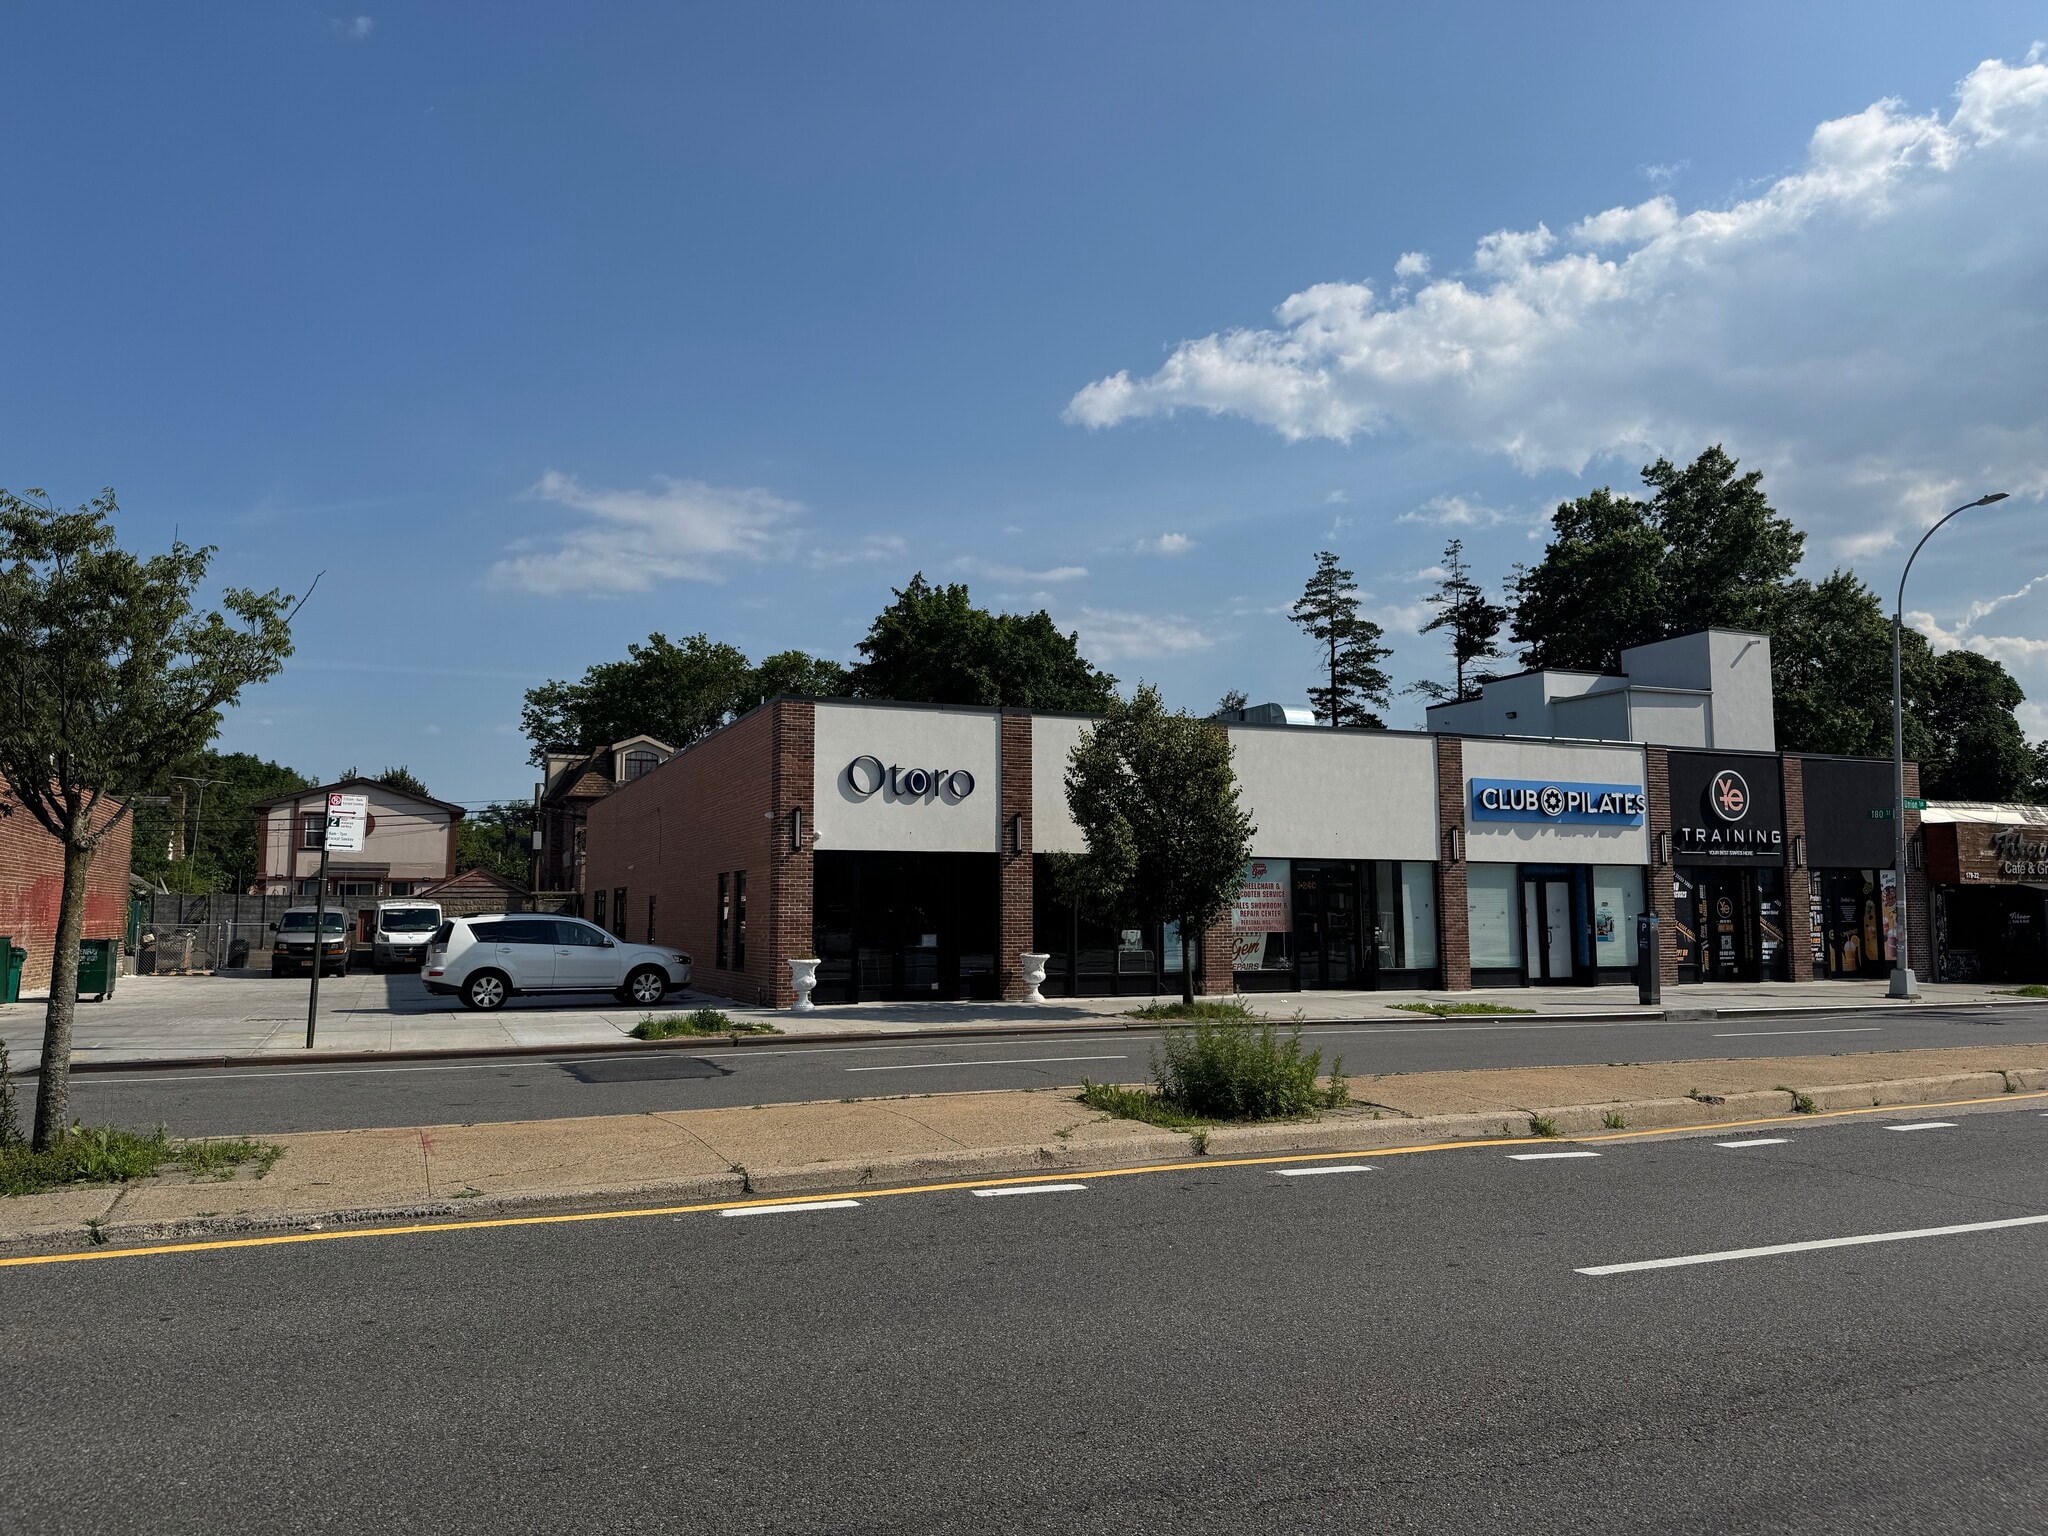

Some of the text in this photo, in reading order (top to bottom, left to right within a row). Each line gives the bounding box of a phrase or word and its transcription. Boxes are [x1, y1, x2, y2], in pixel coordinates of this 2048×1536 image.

[847, 754, 976, 797] Otoro
[1482, 788, 1647, 815] CLUB PILATES
[1904, 799, 1918, 809] Union
[1871, 810, 1884, 819] 180
[330, 817, 338, 827] 2
[1682, 827, 1781, 844] TRAINING
[2004, 861, 2048, 875] Café & Gr
[1244, 882, 1275, 890] HEELCHAIR
[1232, 902, 1250, 910] SALES
[1250, 902, 1282, 910] SHOWROOM
[1240, 910, 1282, 918] REPAIR CENTER
[1641, 922, 1647, 931] P
[1232, 938, 1260, 961] Gem
[1232, 962, 1260, 971] EPAIRS
